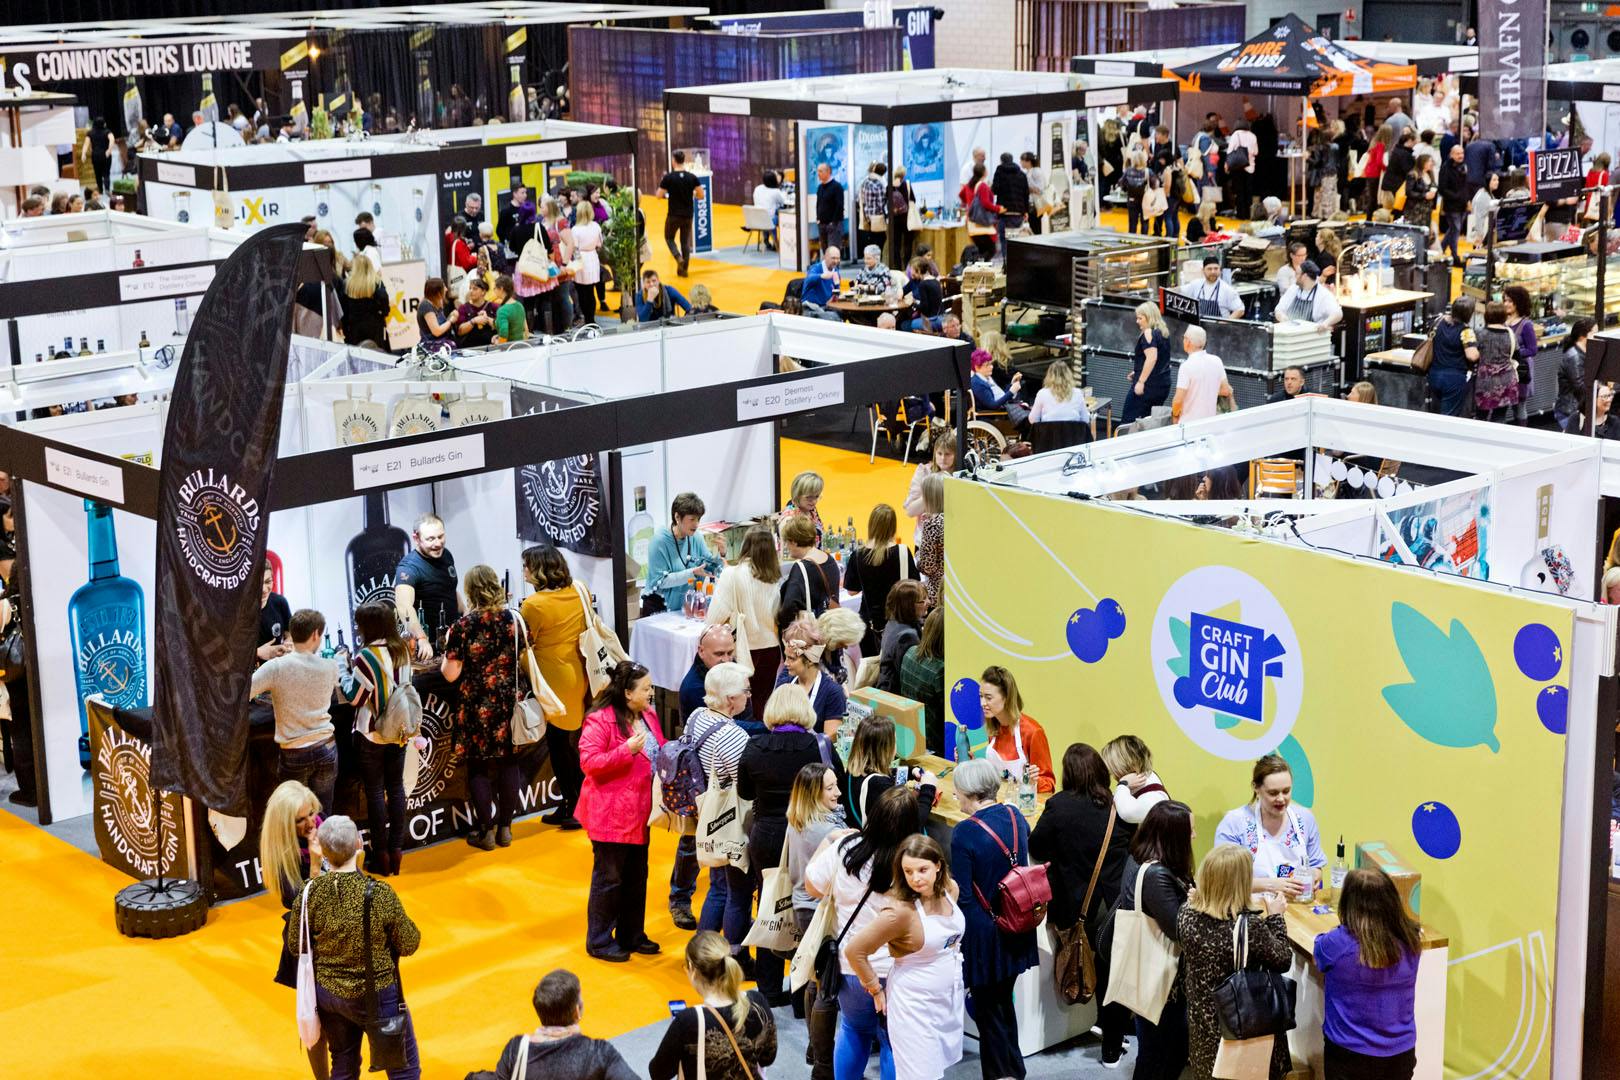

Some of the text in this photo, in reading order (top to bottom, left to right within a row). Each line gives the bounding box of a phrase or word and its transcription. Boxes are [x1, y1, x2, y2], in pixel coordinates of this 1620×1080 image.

[908, 10, 930, 36] GIN
[36, 45, 180, 82] CONNOISSEURS
[182, 40, 253, 73] LOUNGE
[1241, 41, 1287, 56] PURE
[1498, 12, 1521, 114] HRAFN
[1536, 150, 1580, 181] PIZZA
[1166, 293, 1197, 316] PIZZA
[764, 395, 781, 406] E20
[784, 385, 814, 397] Deerness
[784, 395, 812, 407] Distillery
[342, 412, 378, 434] BULLARDS
[386, 450, 463, 472] E21 Bullards Gin
[573, 477, 593, 485] MARK
[178, 468, 261, 531] BULLARDS
[523, 482, 600, 543] HANDCRAFTED GIN
[179, 509, 198, 523] TRADE
[177, 527, 253, 590] HANDCRAFTED GIN
[1201, 624, 1253, 650] CRAFT
[80, 628, 144, 673] BULLARDS
[1200, 642, 1249, 678] GIN
[136, 678, 145, 699] GIN
[1201, 671, 1248, 704] Club
[443, 752, 458, 779] GIN
[409, 808, 445, 841] OF
[101, 803, 179, 877] HANDCRAFTD GIN
[768, 918, 782, 932] GIN
